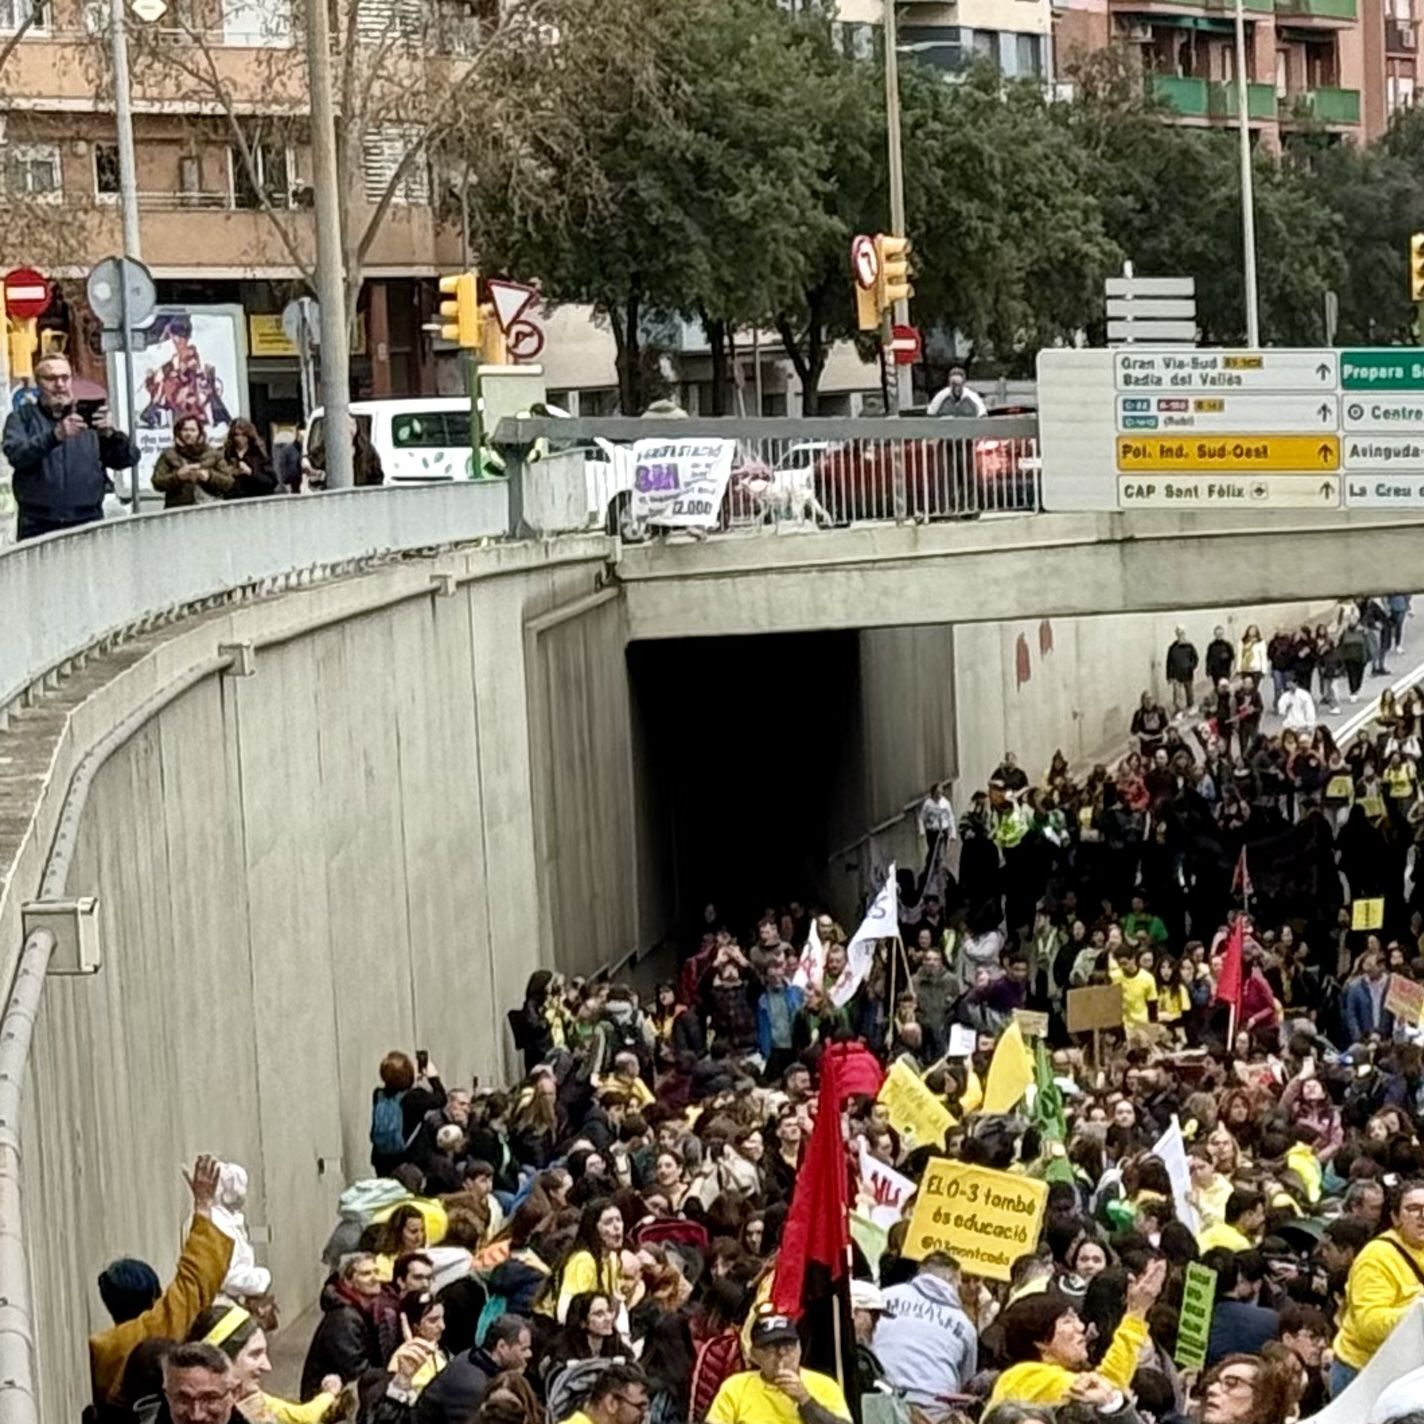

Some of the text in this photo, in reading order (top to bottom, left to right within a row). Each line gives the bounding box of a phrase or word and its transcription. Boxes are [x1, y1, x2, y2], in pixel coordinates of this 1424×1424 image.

[1121, 357, 1155, 370] Gran
[1123, 373, 1163, 387] Badia
[1170, 373, 1193, 387] del
[1343, 363, 1404, 382] Propera
[1371, 405, 1424, 420] Centre
[1122, 444, 1269, 459] Pol. Ind. Sud-Oest
[1124, 484, 1156, 499] CAP
[1165, 483, 1199, 499] Sant
[1350, 483, 1367, 498] La
[1375, 483, 1412, 498] Creu
[946, 1179, 980, 1203] 0-3
[983, 1186, 1036, 1217] també
[932, 1207, 1028, 1243] és educació
